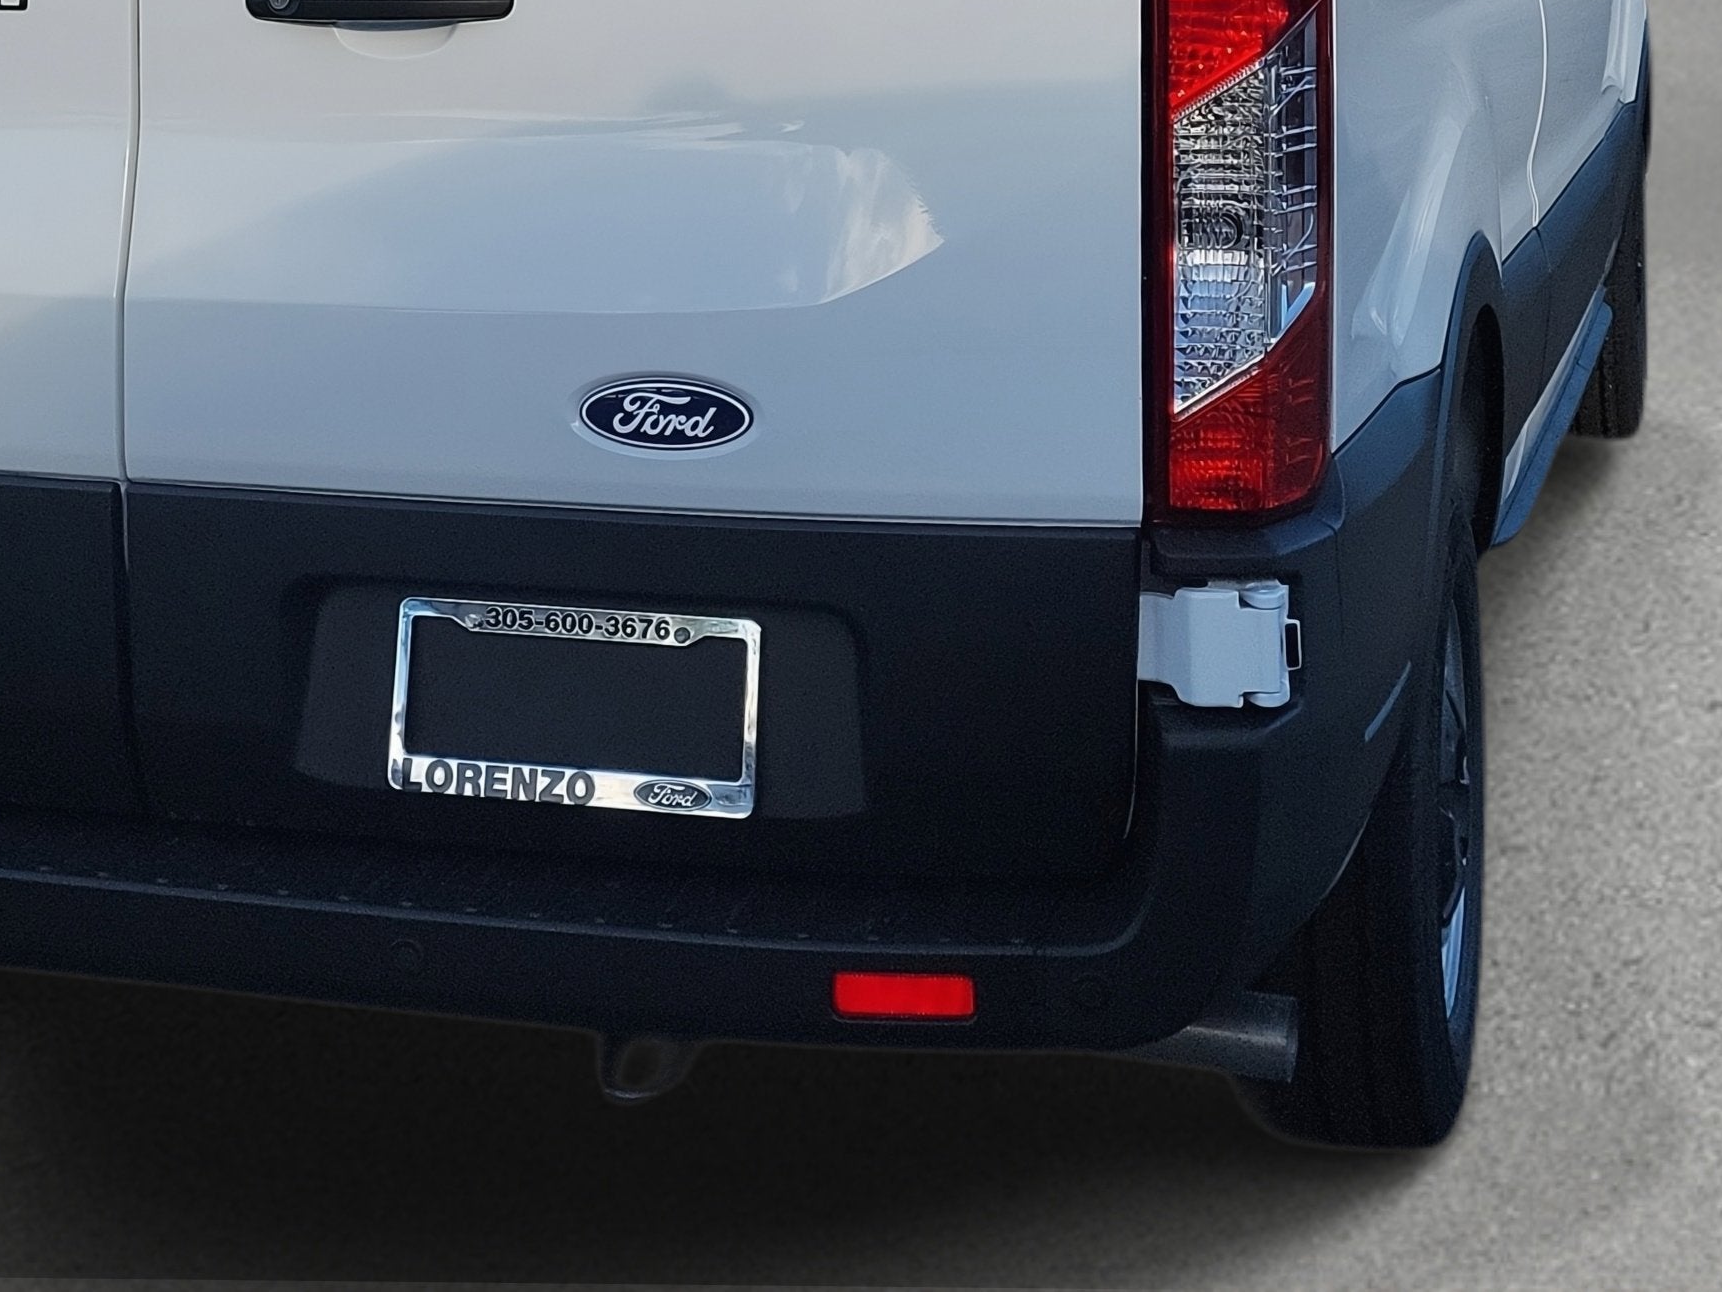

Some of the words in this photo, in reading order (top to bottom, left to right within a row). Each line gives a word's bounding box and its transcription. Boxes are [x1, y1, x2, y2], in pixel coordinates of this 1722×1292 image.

[613, 392, 717, 437] Ford
[485, 607, 671, 641] 305-600-3676
[402, 758, 596, 806] LORENZO
[648, 782, 698, 808] Ford
